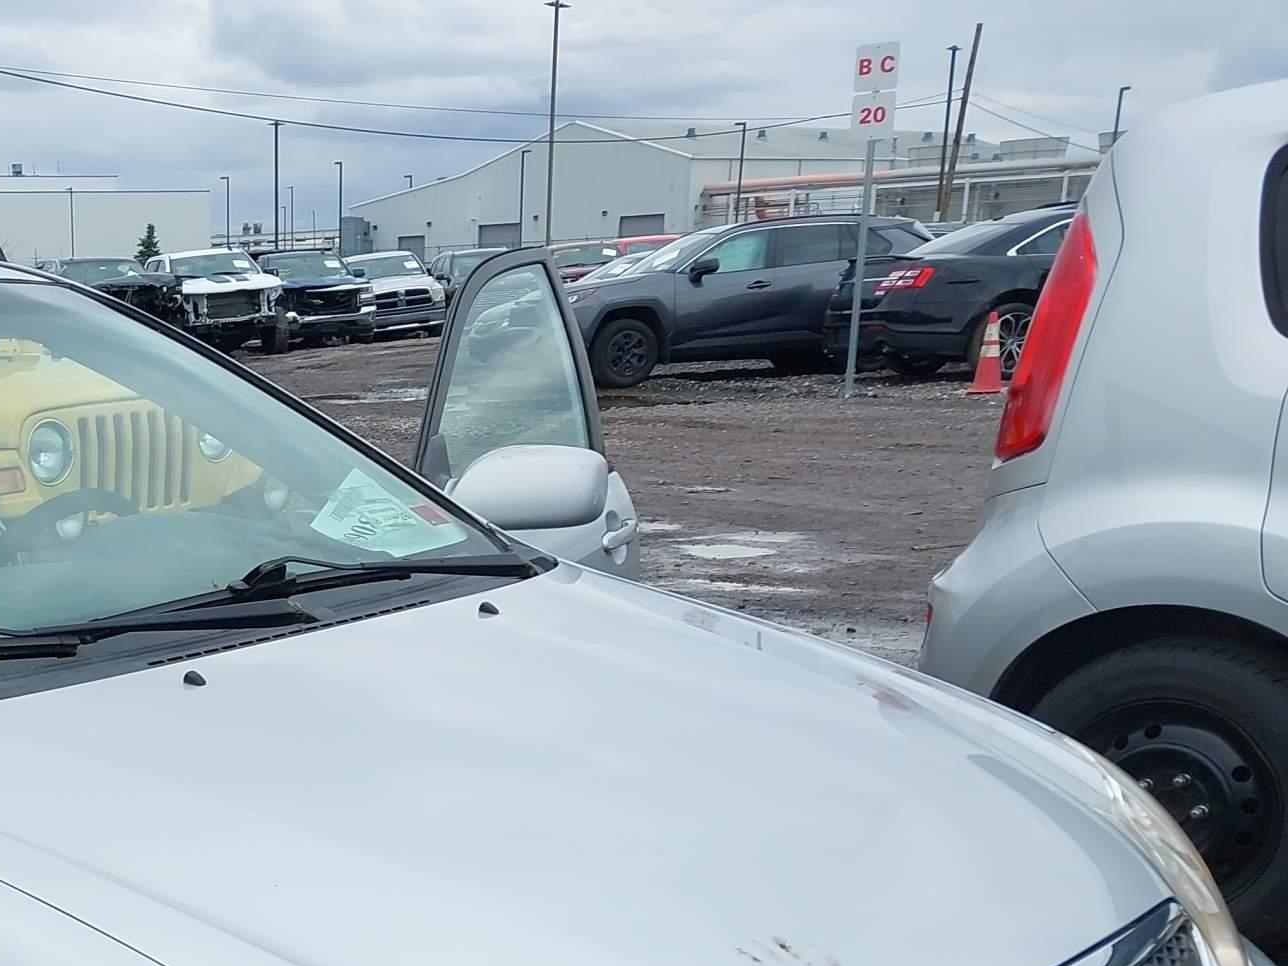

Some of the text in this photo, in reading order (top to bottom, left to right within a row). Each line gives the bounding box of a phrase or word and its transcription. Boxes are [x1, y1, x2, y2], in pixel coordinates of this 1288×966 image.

[858, 55, 895, 76] B C
[859, 106, 886, 125] 20
